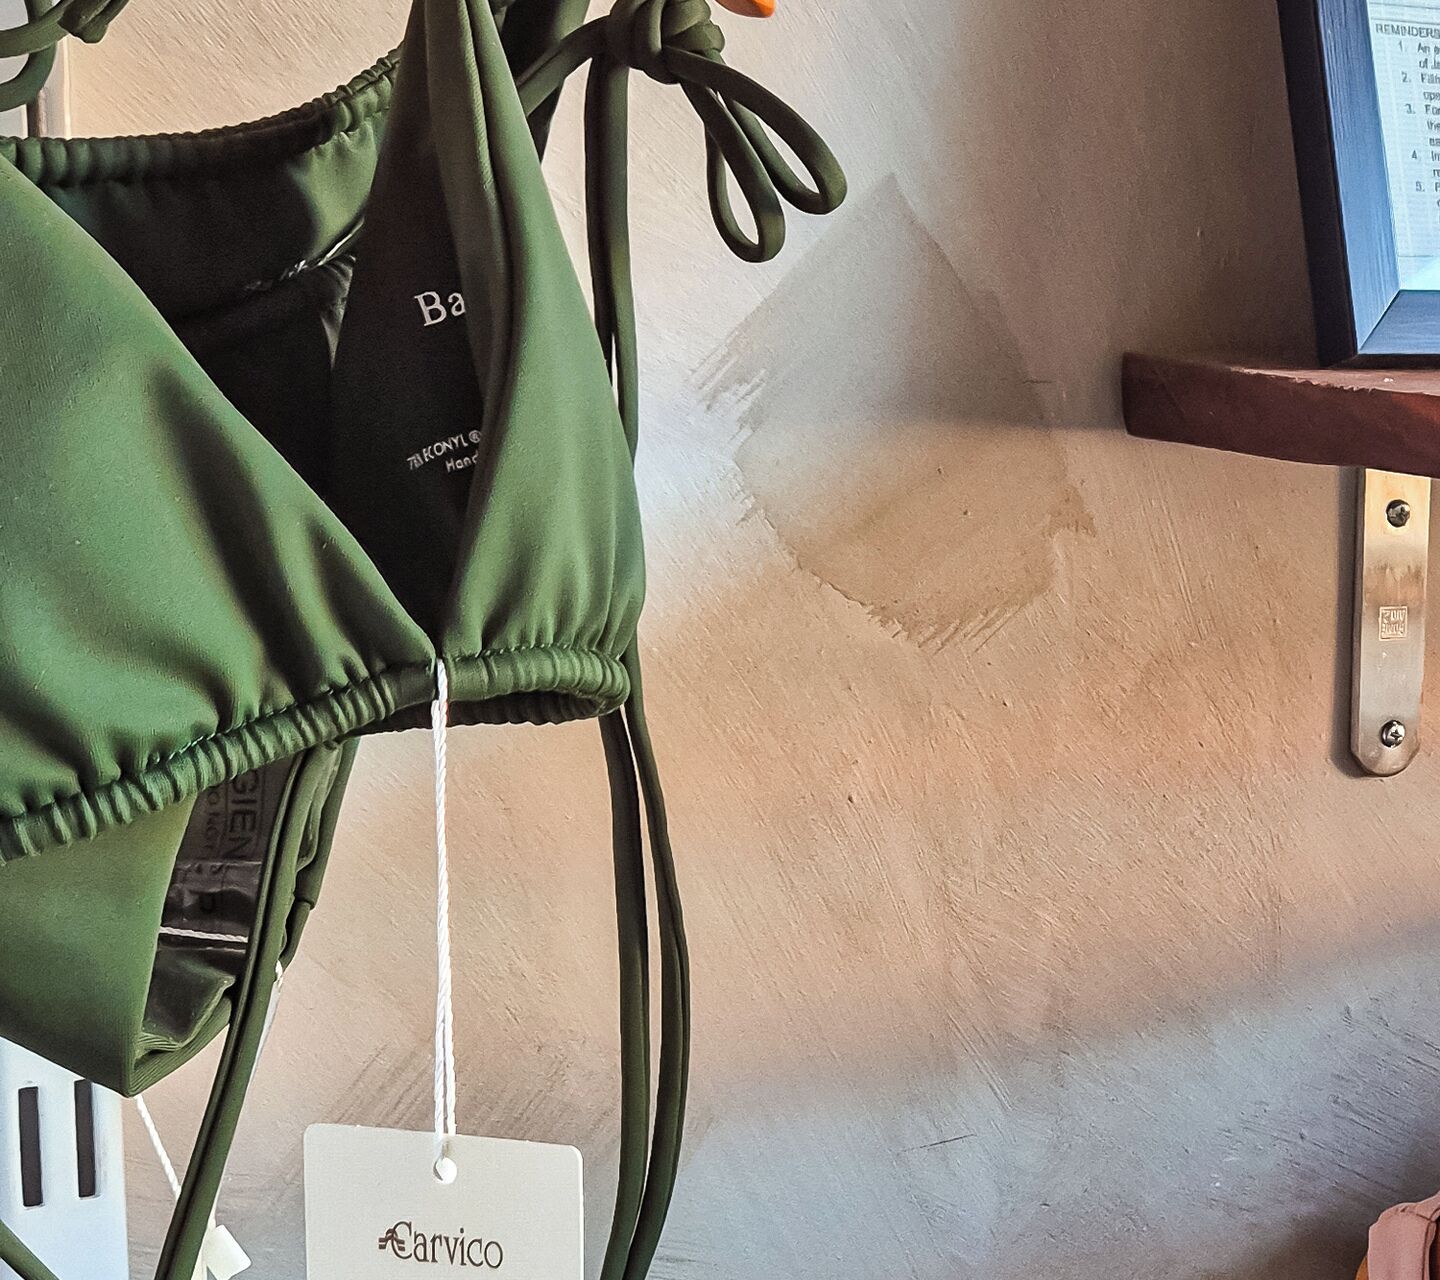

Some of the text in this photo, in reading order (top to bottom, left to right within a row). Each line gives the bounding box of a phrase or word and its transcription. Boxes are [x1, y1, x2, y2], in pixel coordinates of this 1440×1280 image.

[1417, 42, 1431, 53] An
[414, 291, 467, 327] Ba
[384, 1221, 504, 1269] Carvico
